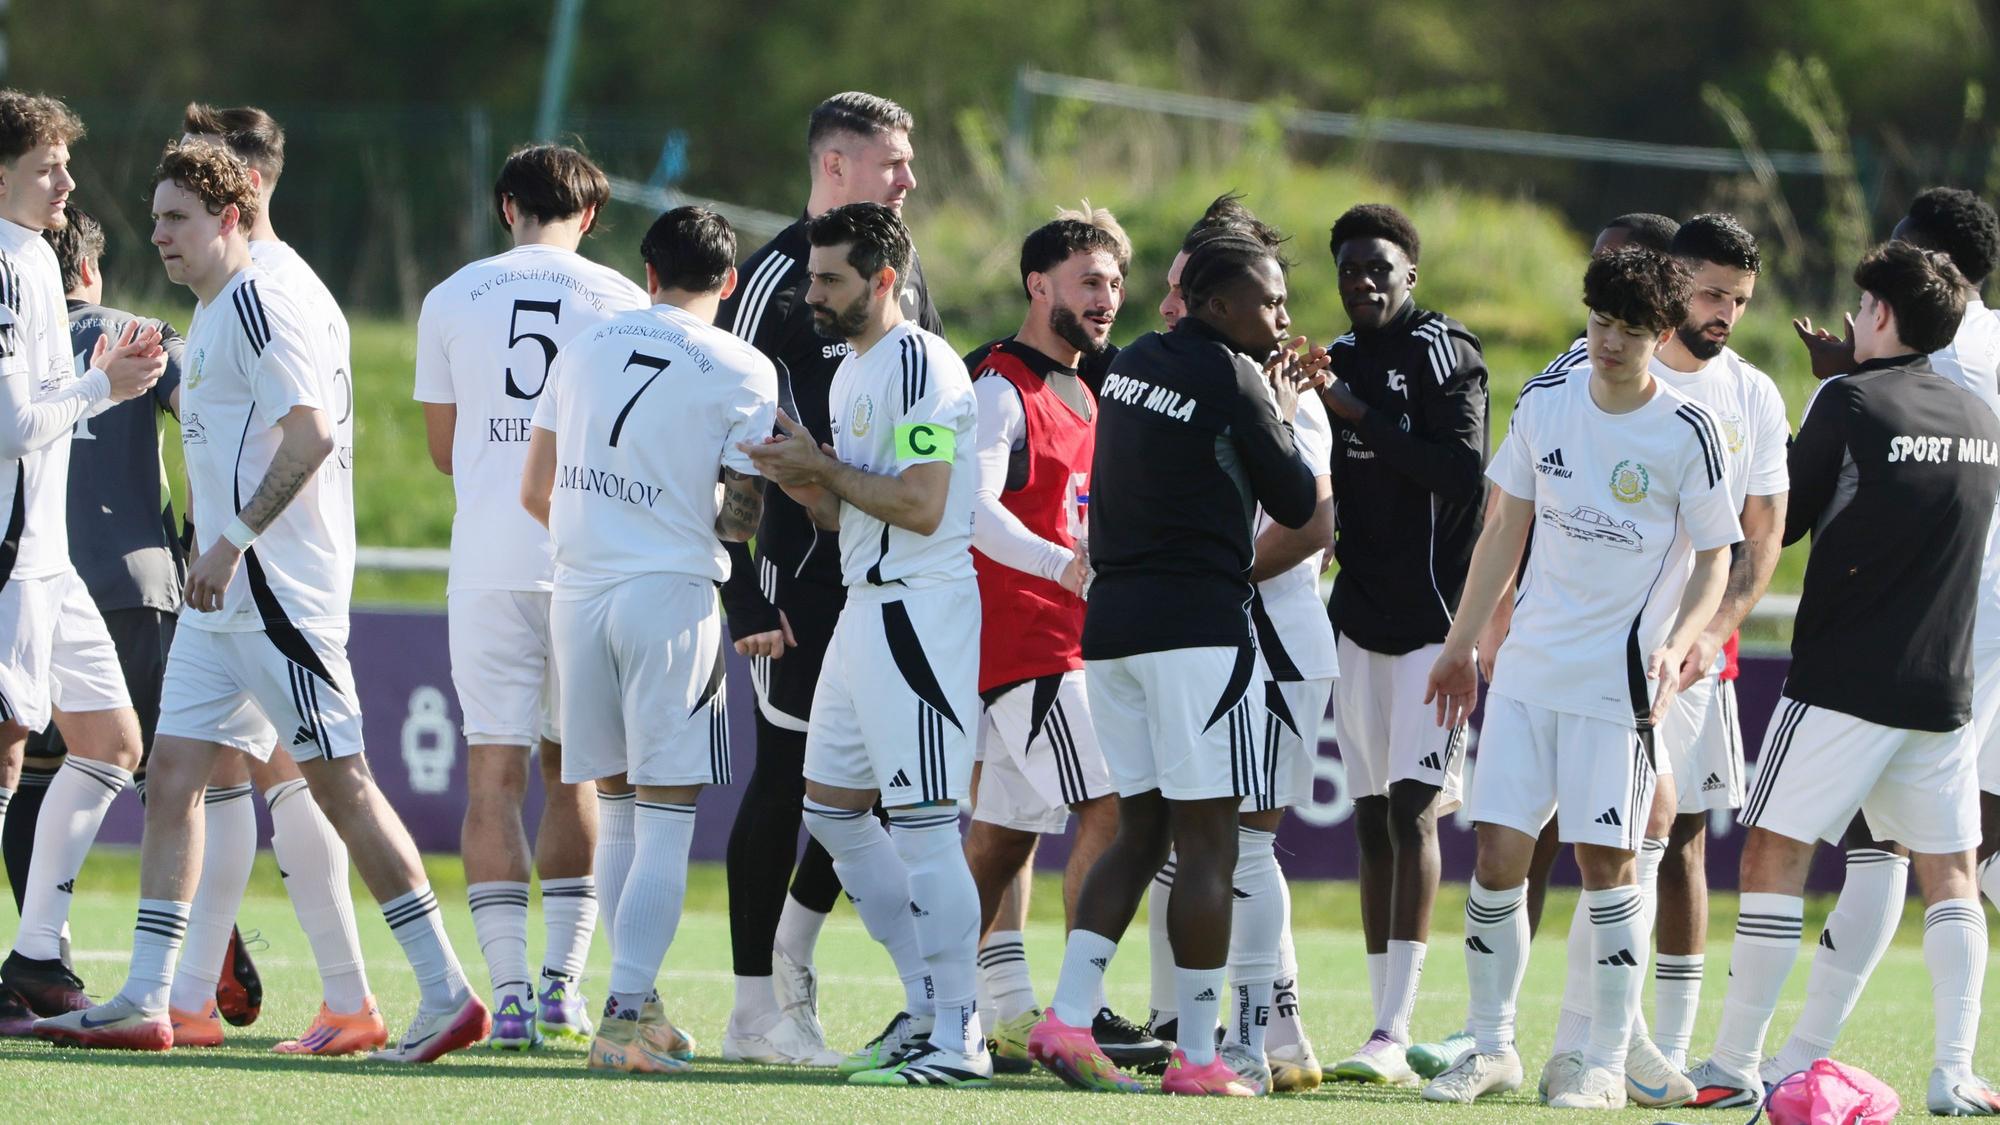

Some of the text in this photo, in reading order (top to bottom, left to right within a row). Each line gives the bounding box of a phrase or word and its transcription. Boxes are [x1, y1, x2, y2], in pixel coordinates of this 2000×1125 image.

[470, 279, 492, 301] BCV
[505, 299, 562, 401] 5
[609, 349, 671, 448] 7
[1143, 385, 1197, 423] MILA
[488, 417, 532, 443] KHE
[908, 425, 938, 456] C
[1888, 435, 1999, 467] SPORT MILA
[560, 465, 663, 509] MANOLOV
[1553, 468, 1574, 480] MILA
